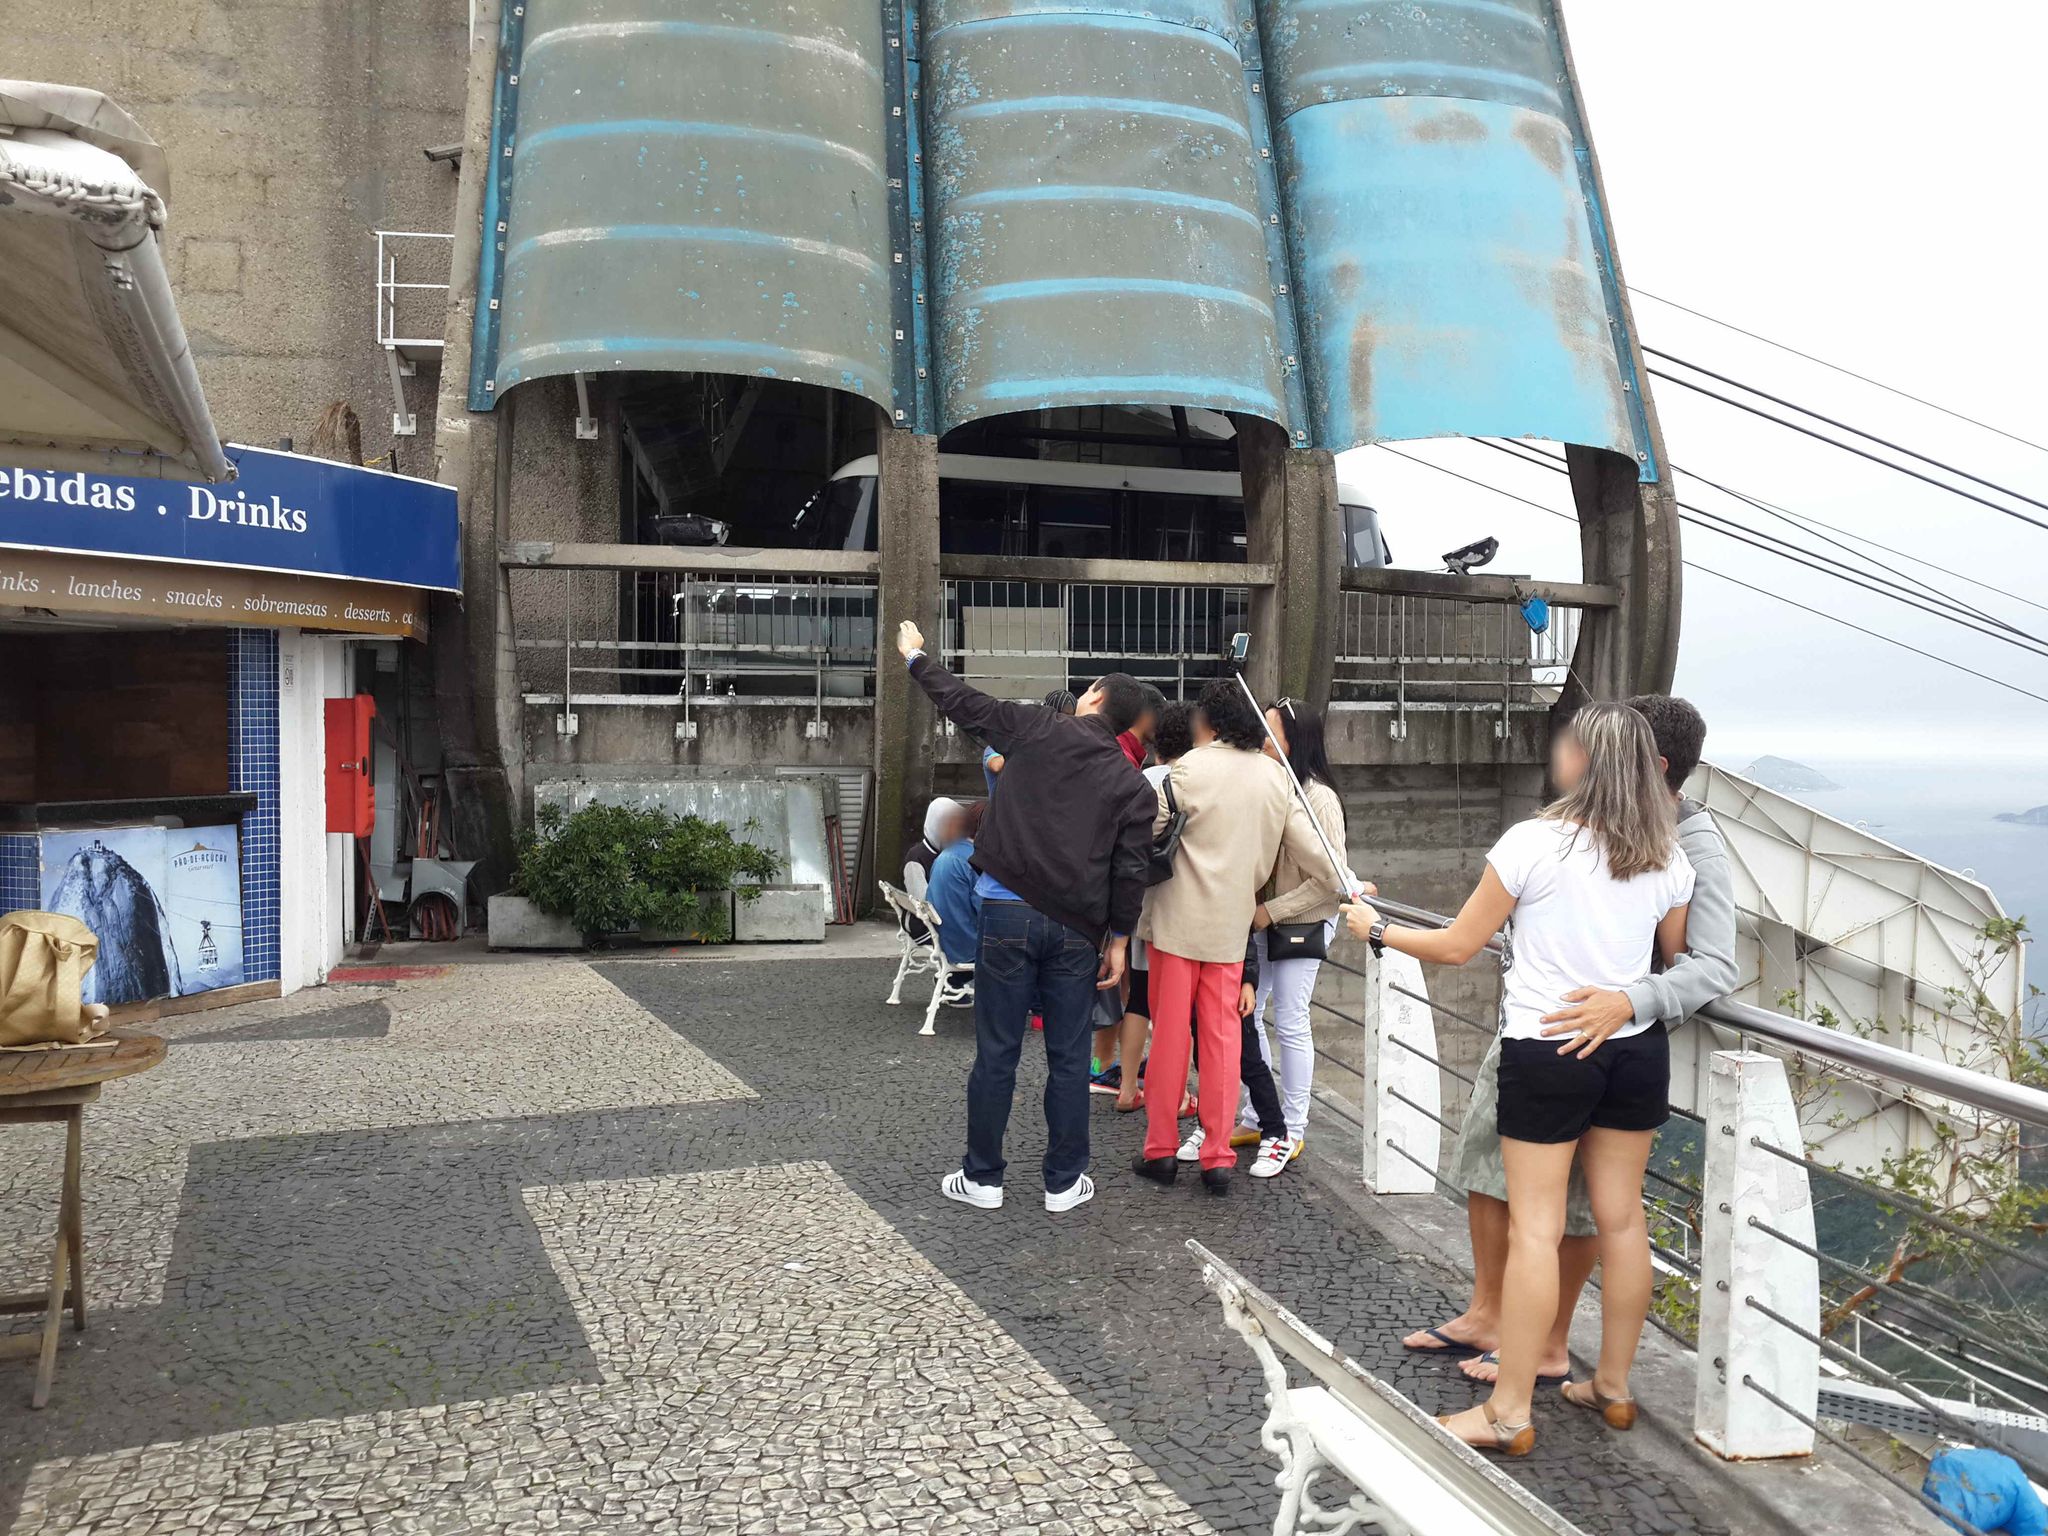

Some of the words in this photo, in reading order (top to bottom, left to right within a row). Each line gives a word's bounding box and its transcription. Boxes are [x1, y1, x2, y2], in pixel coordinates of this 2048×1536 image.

[187, 485, 307, 533] Drinks
[0, 570, 40, 592] nks
[68, 575, 142, 601] lanches
[165, 588, 223, 608] snacks
[243, 594, 328, 617] sobremesas
[344, 602, 391, 623] desserts
